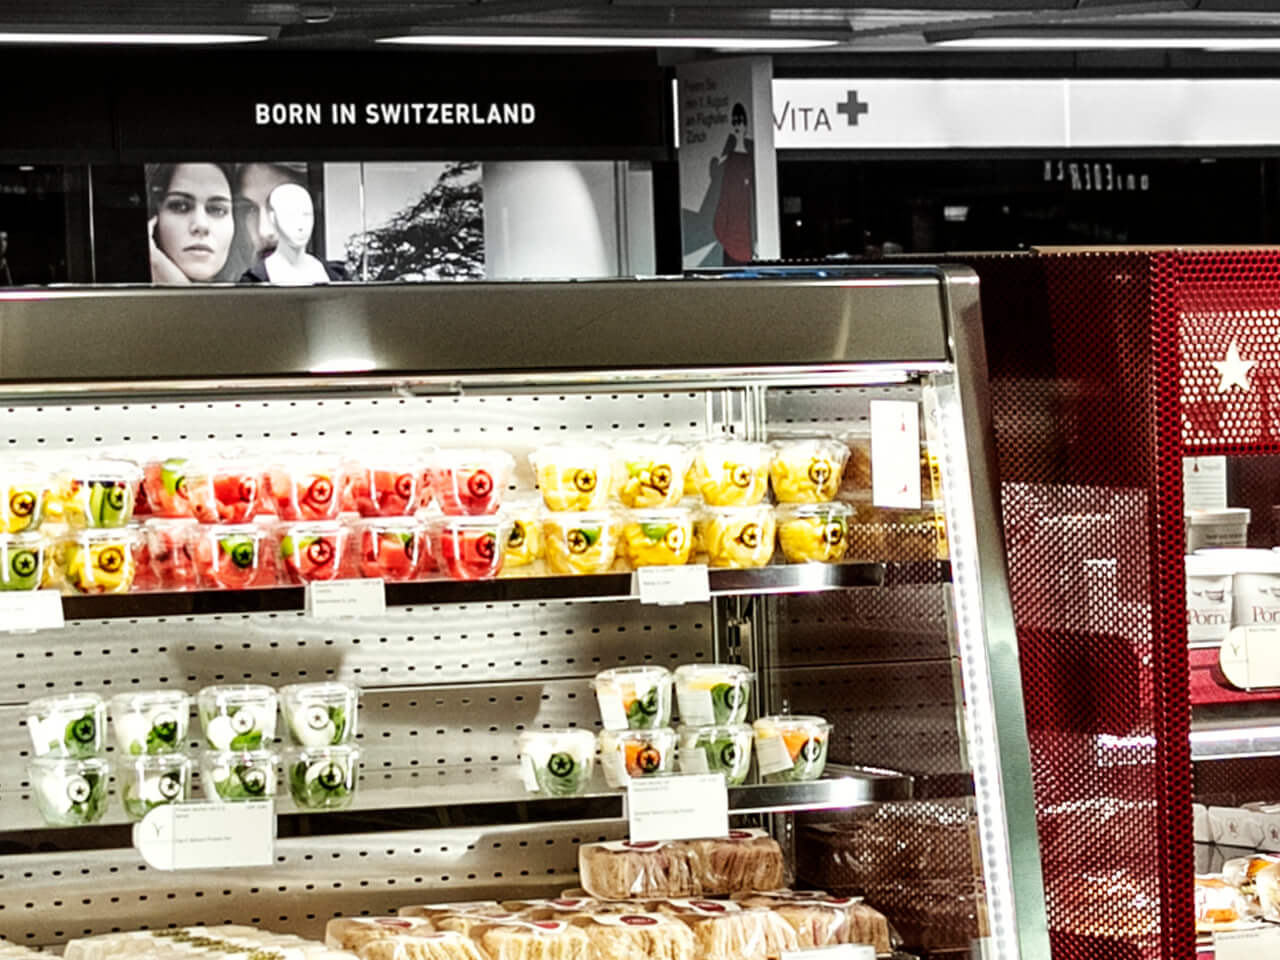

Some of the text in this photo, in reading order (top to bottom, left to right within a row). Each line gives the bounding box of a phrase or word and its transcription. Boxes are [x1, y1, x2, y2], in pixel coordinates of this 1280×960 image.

[255, 103, 536, 124] BORN IN SWITZERLAND
